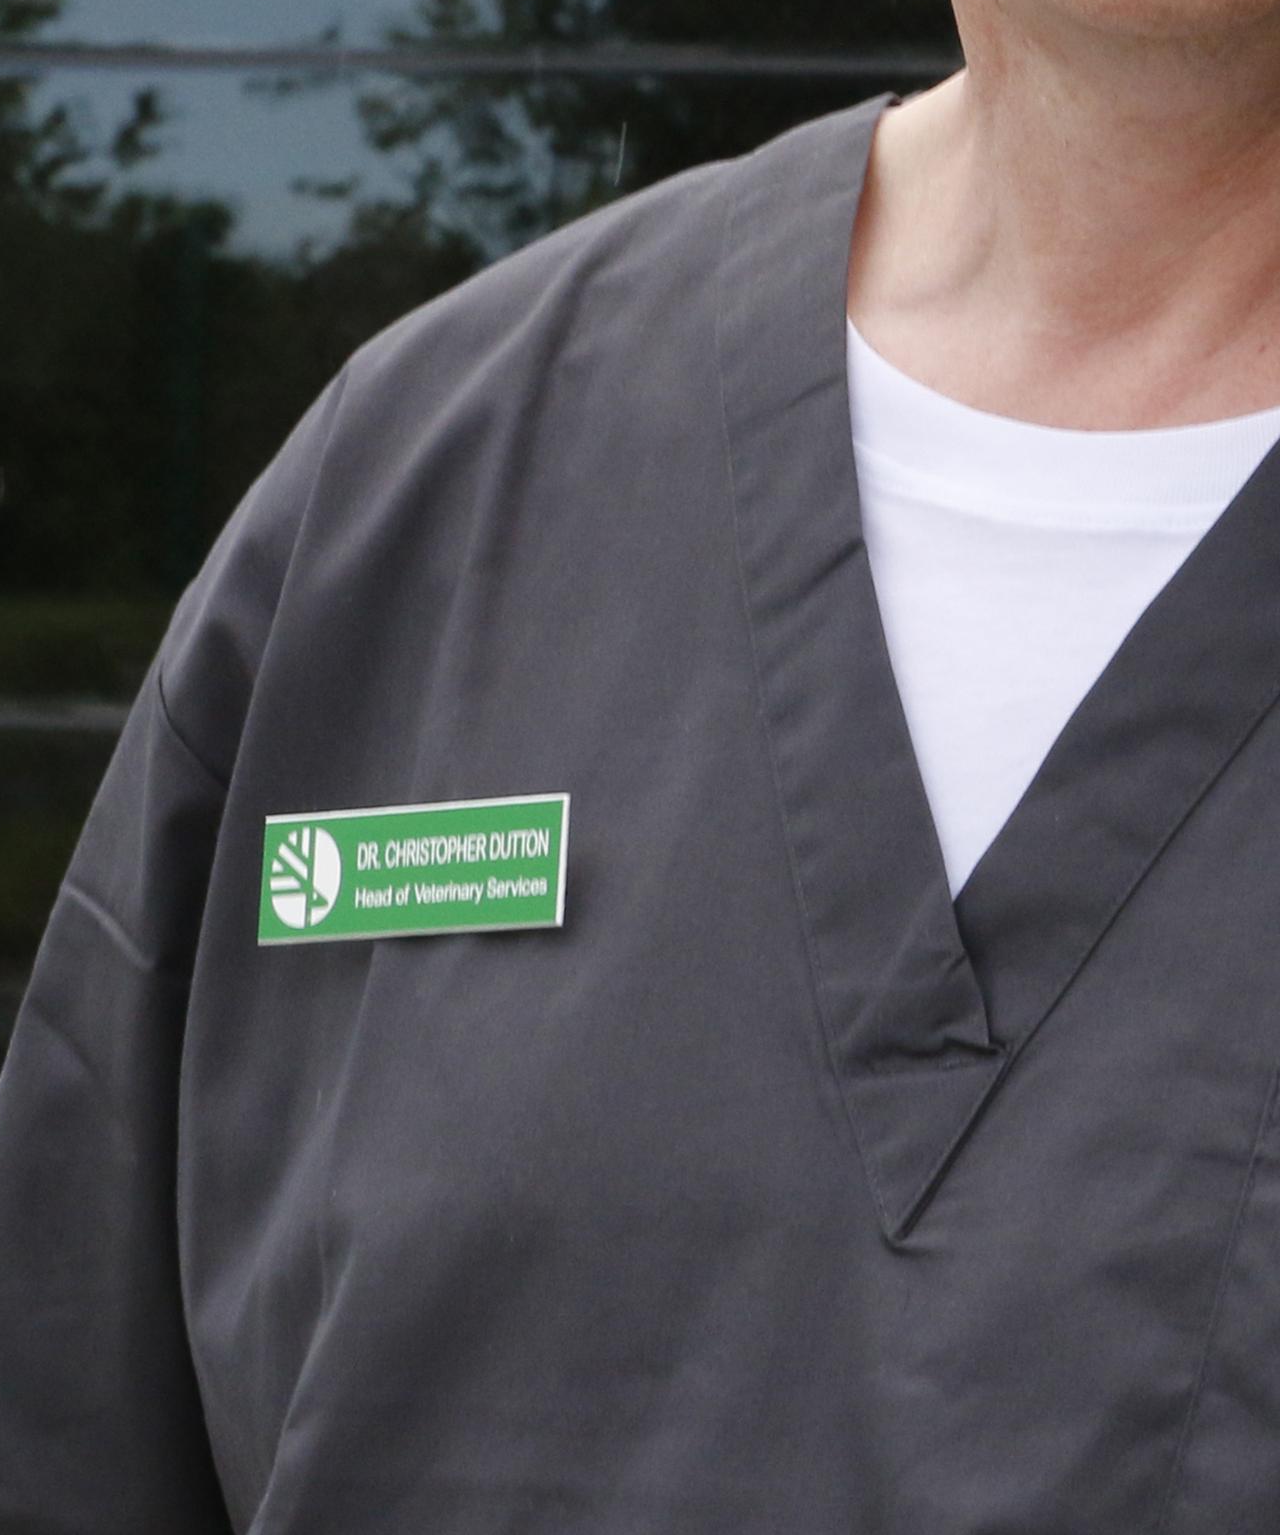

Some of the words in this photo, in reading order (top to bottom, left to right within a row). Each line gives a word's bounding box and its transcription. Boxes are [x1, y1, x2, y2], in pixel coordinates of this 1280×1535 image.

[357, 841, 382, 871] DR.
[384, 833, 487, 869] CHRISTOPHER
[489, 828, 550, 861] DUTTON
[354, 884, 393, 909] Head
[395, 882, 411, 906] of
[413, 880, 484, 905] Veterinary
[486, 875, 548, 899] Services
